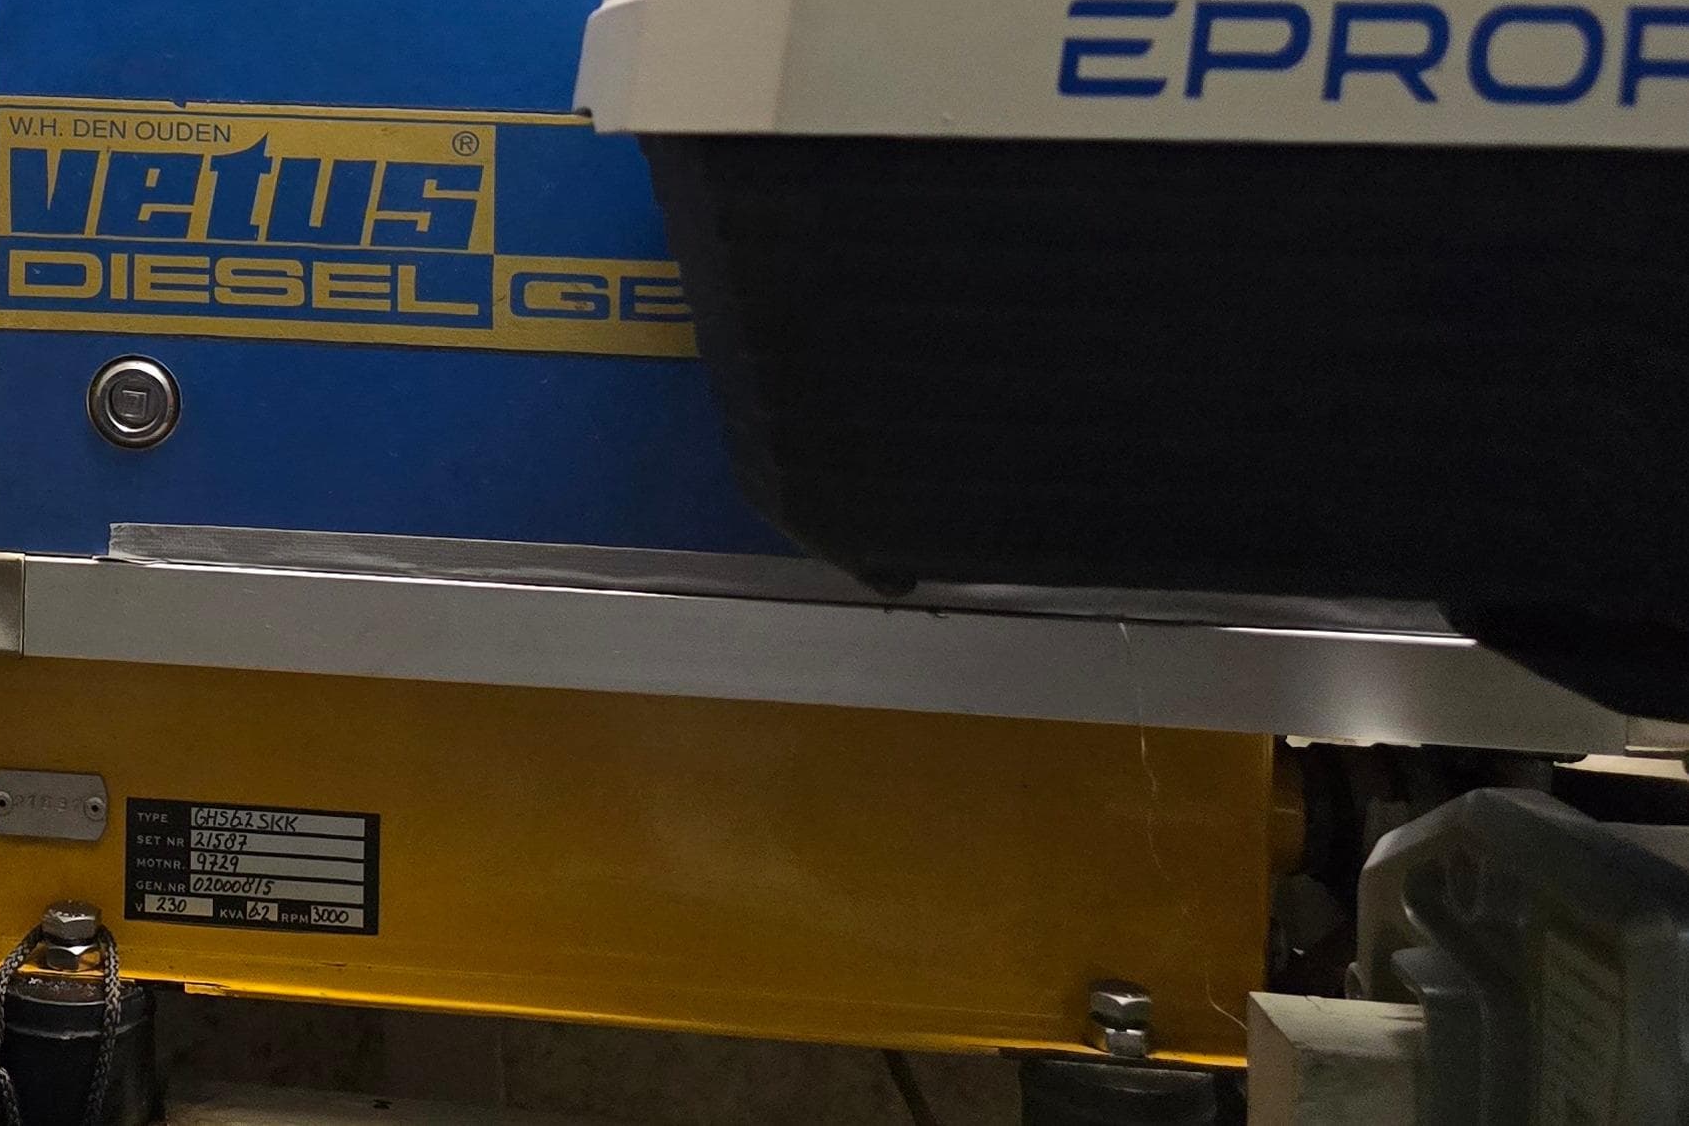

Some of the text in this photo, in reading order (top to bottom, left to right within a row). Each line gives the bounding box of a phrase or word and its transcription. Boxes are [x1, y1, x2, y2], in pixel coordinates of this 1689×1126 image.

[9, 116, 231, 143] W.H. DEN OUDEN
[9, 131, 485, 251] vetus
[8, 249, 693, 323] DIESEL GE
[137, 811, 169, 824] TYPE
[136, 831, 248, 851] SET NR 21587
[135, 853, 240, 874] MOTNR. 9729
[193, 875, 275, 897] 02000815
[134, 902, 143, 912] V
[155, 896, 188, 913] 230
[219, 908, 245, 920] KVA
[281, 912, 309, 924] RPM
[312, 906, 350, 924] 3000
